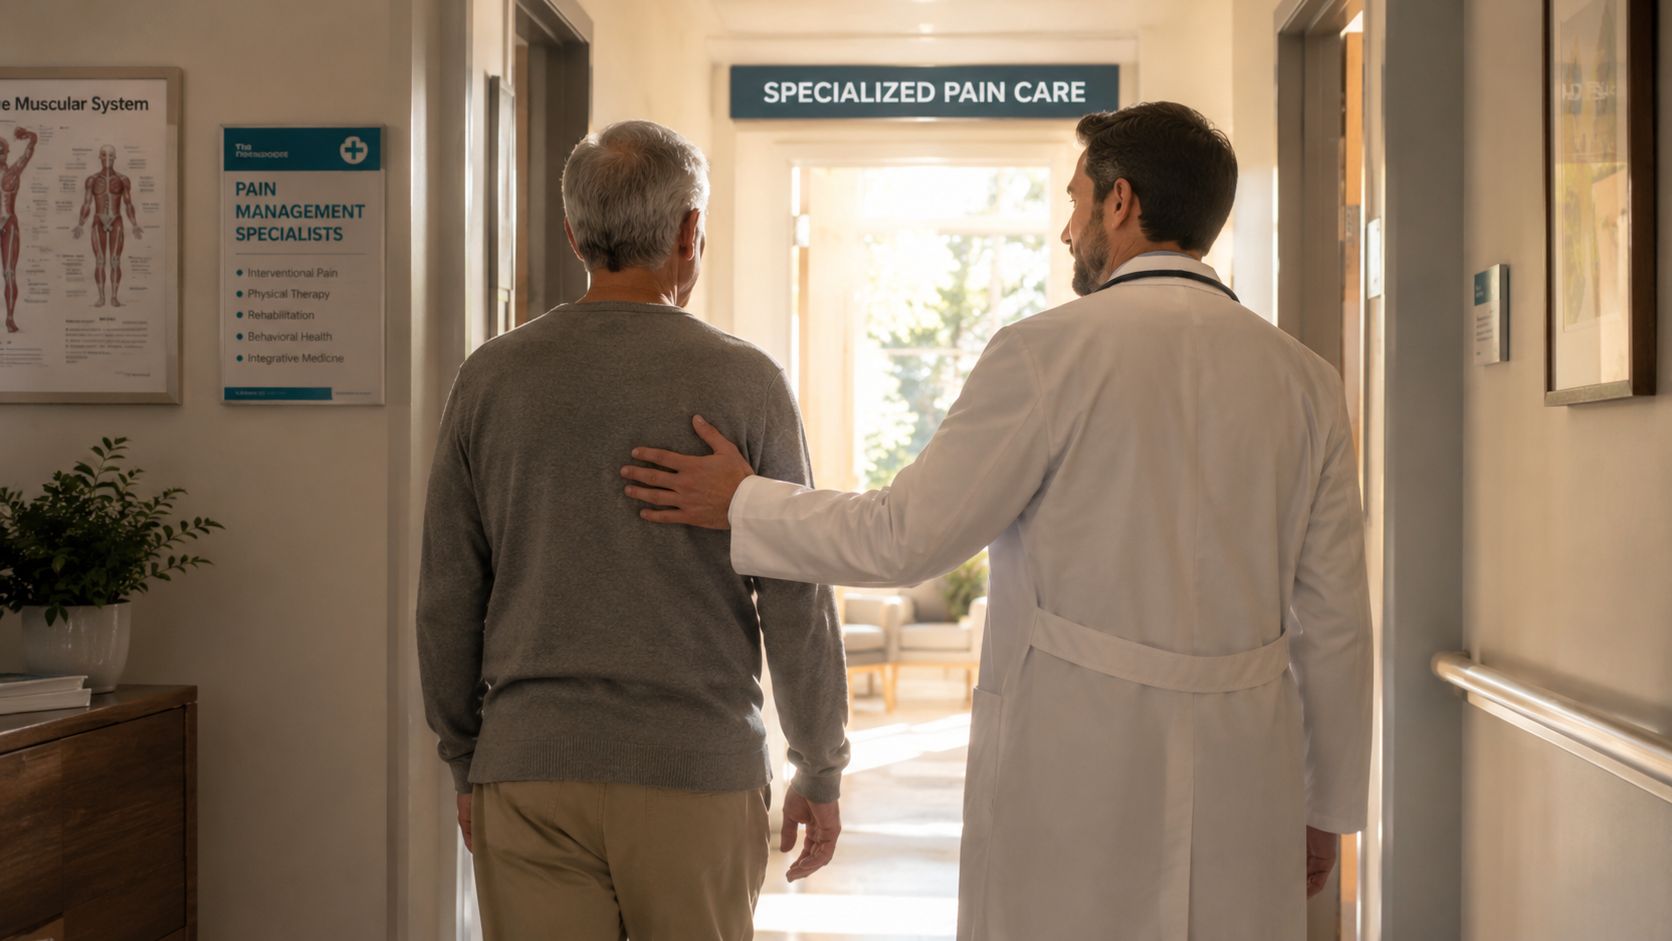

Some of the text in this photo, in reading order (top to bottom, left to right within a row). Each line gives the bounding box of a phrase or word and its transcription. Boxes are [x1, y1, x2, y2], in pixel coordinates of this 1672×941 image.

[764, 81, 1085, 103] SPECIALIZED PAIN CARE
[0, 96, 148, 114] e Muscular System
[236, 182, 276, 196] PAIN
[236, 204, 365, 219] MANAGEMENT
[236, 227, 343, 241] SPECIALISTS
[248, 268, 338, 278] Interventional Pain
[248, 289, 330, 301] Physical Therapy
[248, 310, 314, 320] Rehabilitation
[248, 331, 332, 342] Behavioral Health
[248, 353, 299, 365] Integrative
